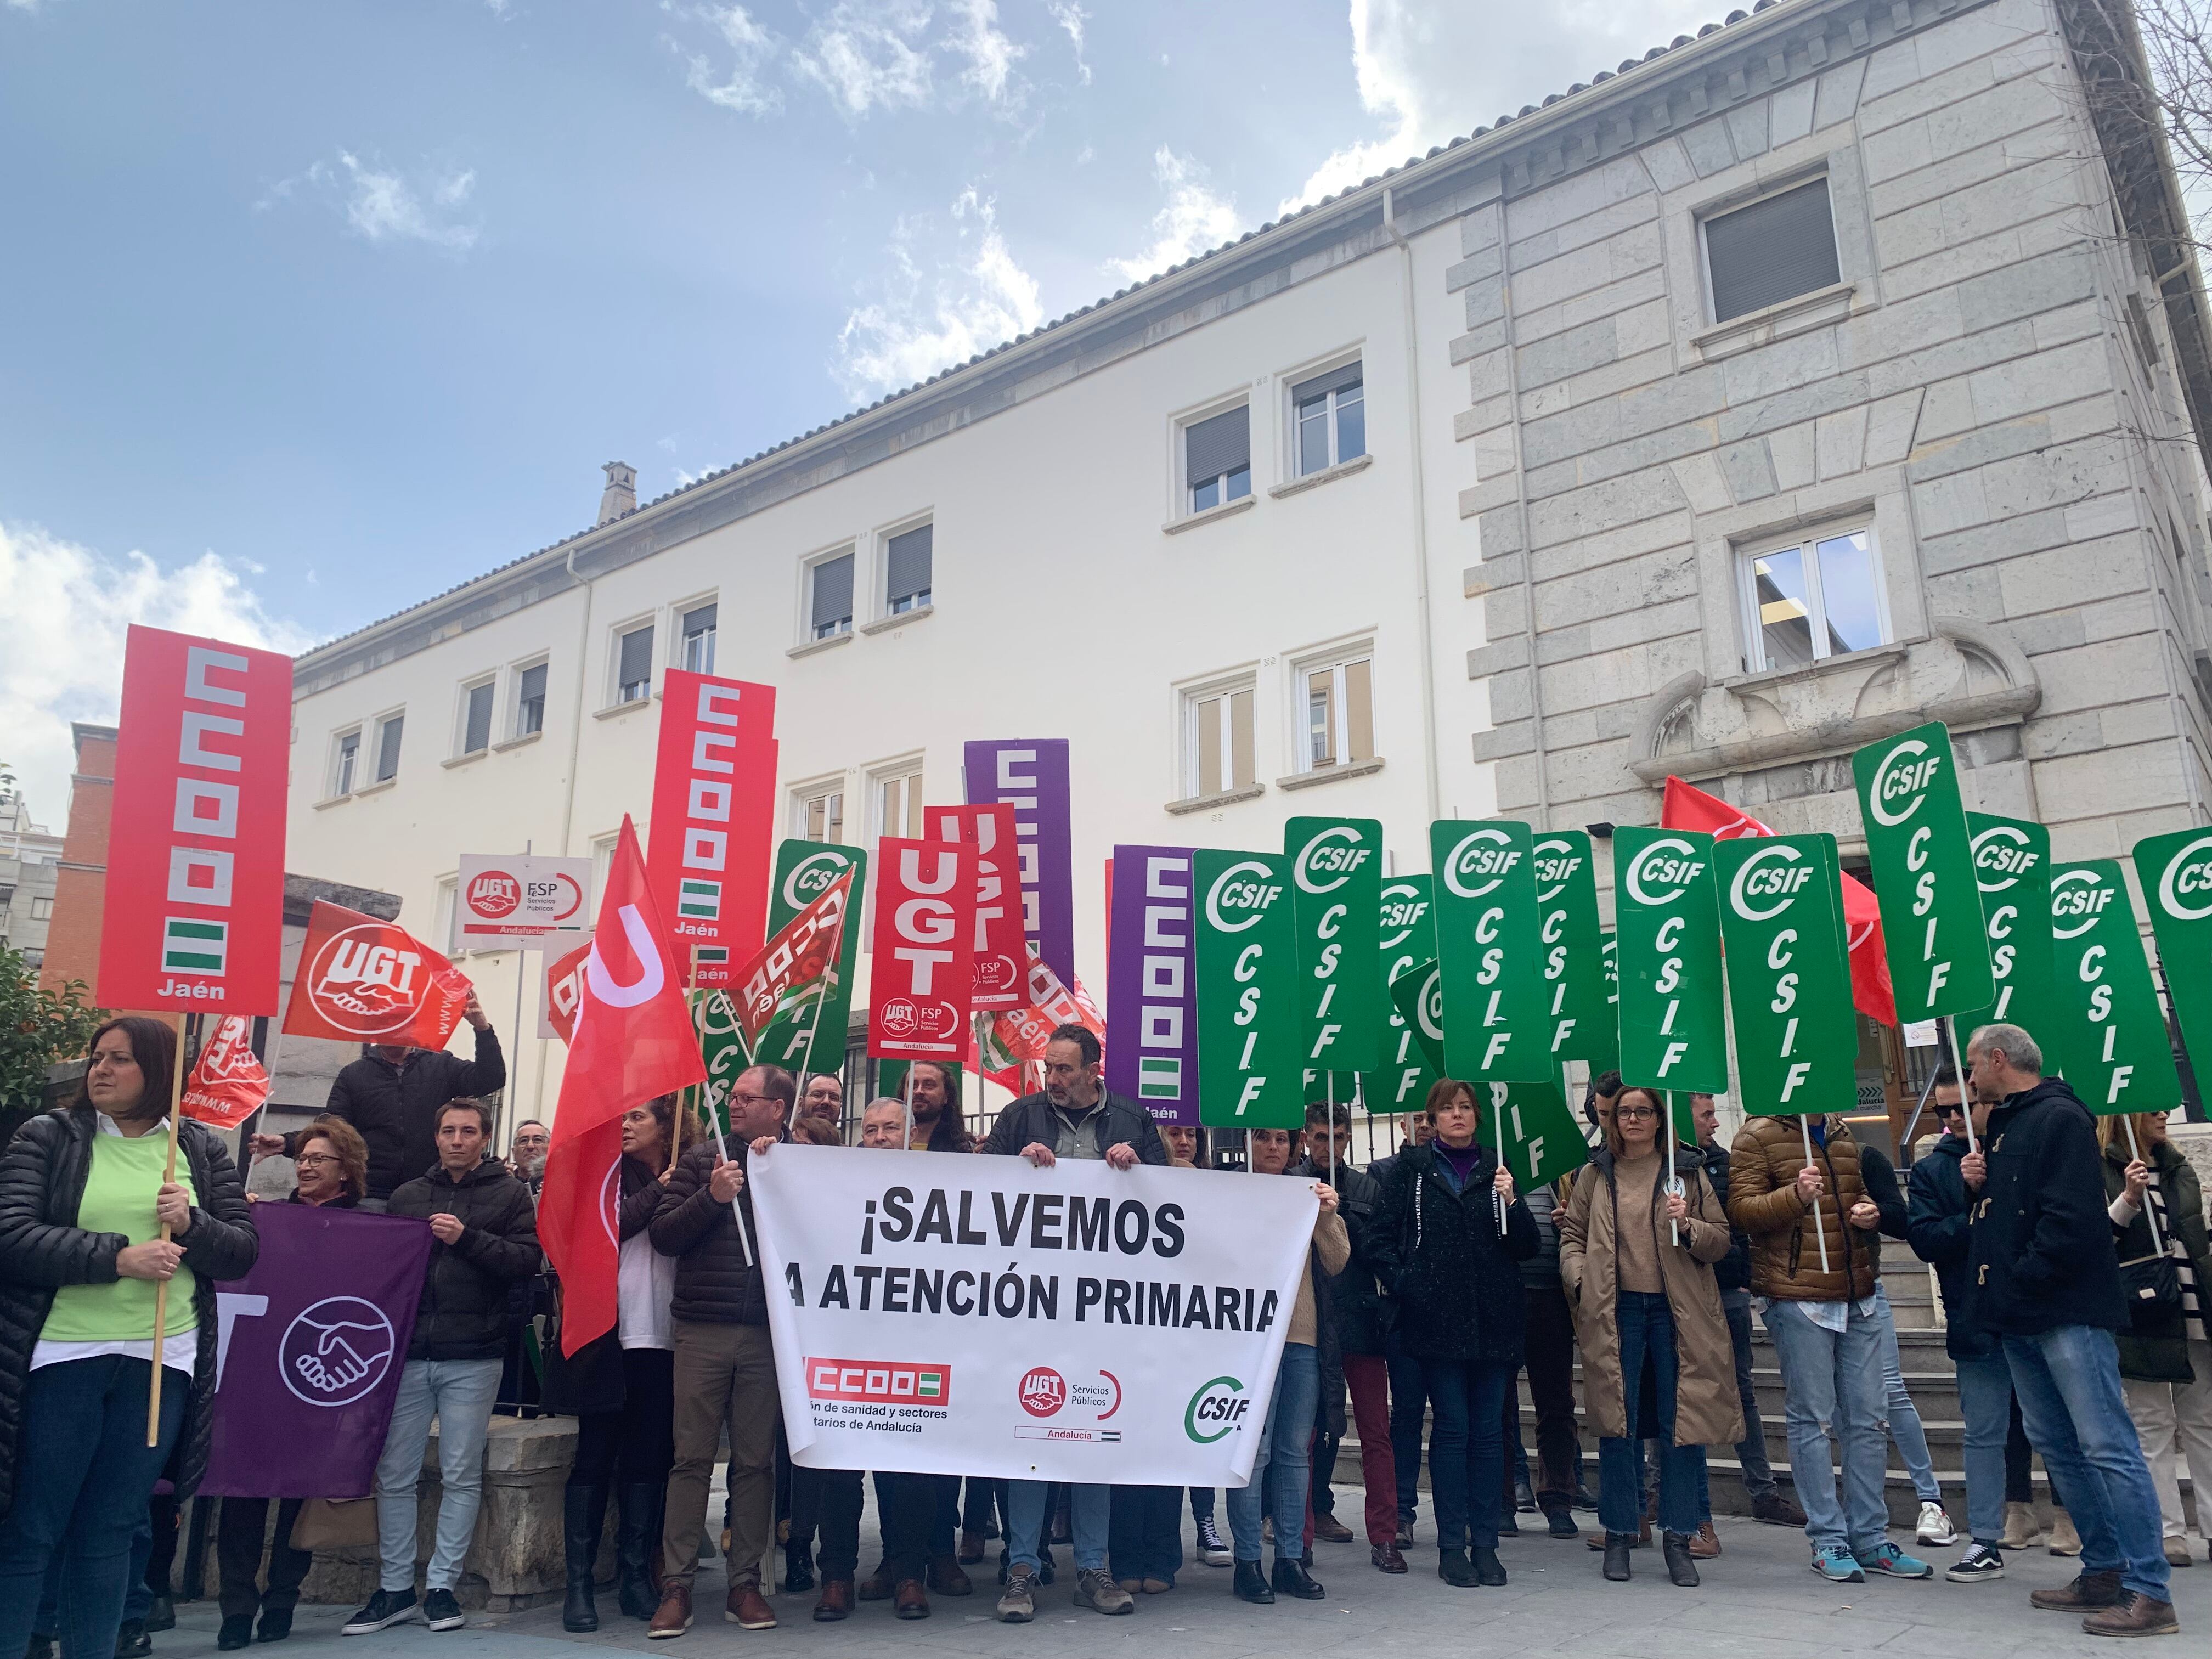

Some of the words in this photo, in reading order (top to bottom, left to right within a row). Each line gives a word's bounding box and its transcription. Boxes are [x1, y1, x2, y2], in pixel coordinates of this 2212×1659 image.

[167, 645, 249, 907] CCOO
[682, 682, 741, 872] CCOO
[1883, 755, 1941, 800] CSIF
[1309, 848, 1372, 872] CSIF
[1458, 850, 1522, 875] CSIF
[1641, 857, 1706, 886] CSIF
[1976, 845, 2040, 874] CSIF
[473, 878, 515, 898] UGT
[1746, 866, 1814, 895] CSIF
[1221, 881, 1283, 910] CSIF
[2052, 888, 2115, 916] CSIF
[674, 921, 719, 938] Jaén
[894, 848, 958, 996] UGT
[1906, 826, 1951, 1008] CSIF
[328, 938, 422, 994] UGT
[1139, 856, 1189, 1049] CCOO
[1987, 905, 2018, 1021] CSI
[687, 968, 729, 980] aén
[981, 962, 1001, 974] FSP
[1310, 904, 1347, 1058] CSIF
[1542, 909, 1576, 1053] CSIF
[157, 978, 225, 1000] Jaén
[1475, 906, 1511, 1070] CSIF
[1655, 917, 1689, 1078] CSIF
[885, 1004, 913, 1019] UGT
[921, 1008, 943, 1020] FSP
[1768, 928, 1812, 1103] CSIF
[2079, 944, 2134, 1104] CSIF
[1007, 1008, 1051, 1051] aén
[1233, 944, 1267, 1116] CSIF
[1145, 1106, 1178, 1119] aén
[860, 1186, 1186, 1259] ¡SALVEMOS
[819, 1262, 1059, 1321] ATENCIÓN
[1075, 1277, 1278, 1333] PRIMARIA
[812, 1365, 916, 1396] CCOO
[1024, 1374, 1062, 1396] UGT
[1071, 1383, 1110, 1396] Servicios
[824, 1402, 838, 1414] de
[841, 1404, 887, 1417] sanidad
[889, 1408, 896, 1419] y
[899, 1408, 948, 1419] sectores
[1071, 1395, 1107, 1407] Públicos
[1197, 1396, 1250, 1422] CSIF
[849, 1419, 864, 1430] de
[865, 1420, 923, 1434] Andalucía
[1047, 1429, 1092, 1440] Andalucía
